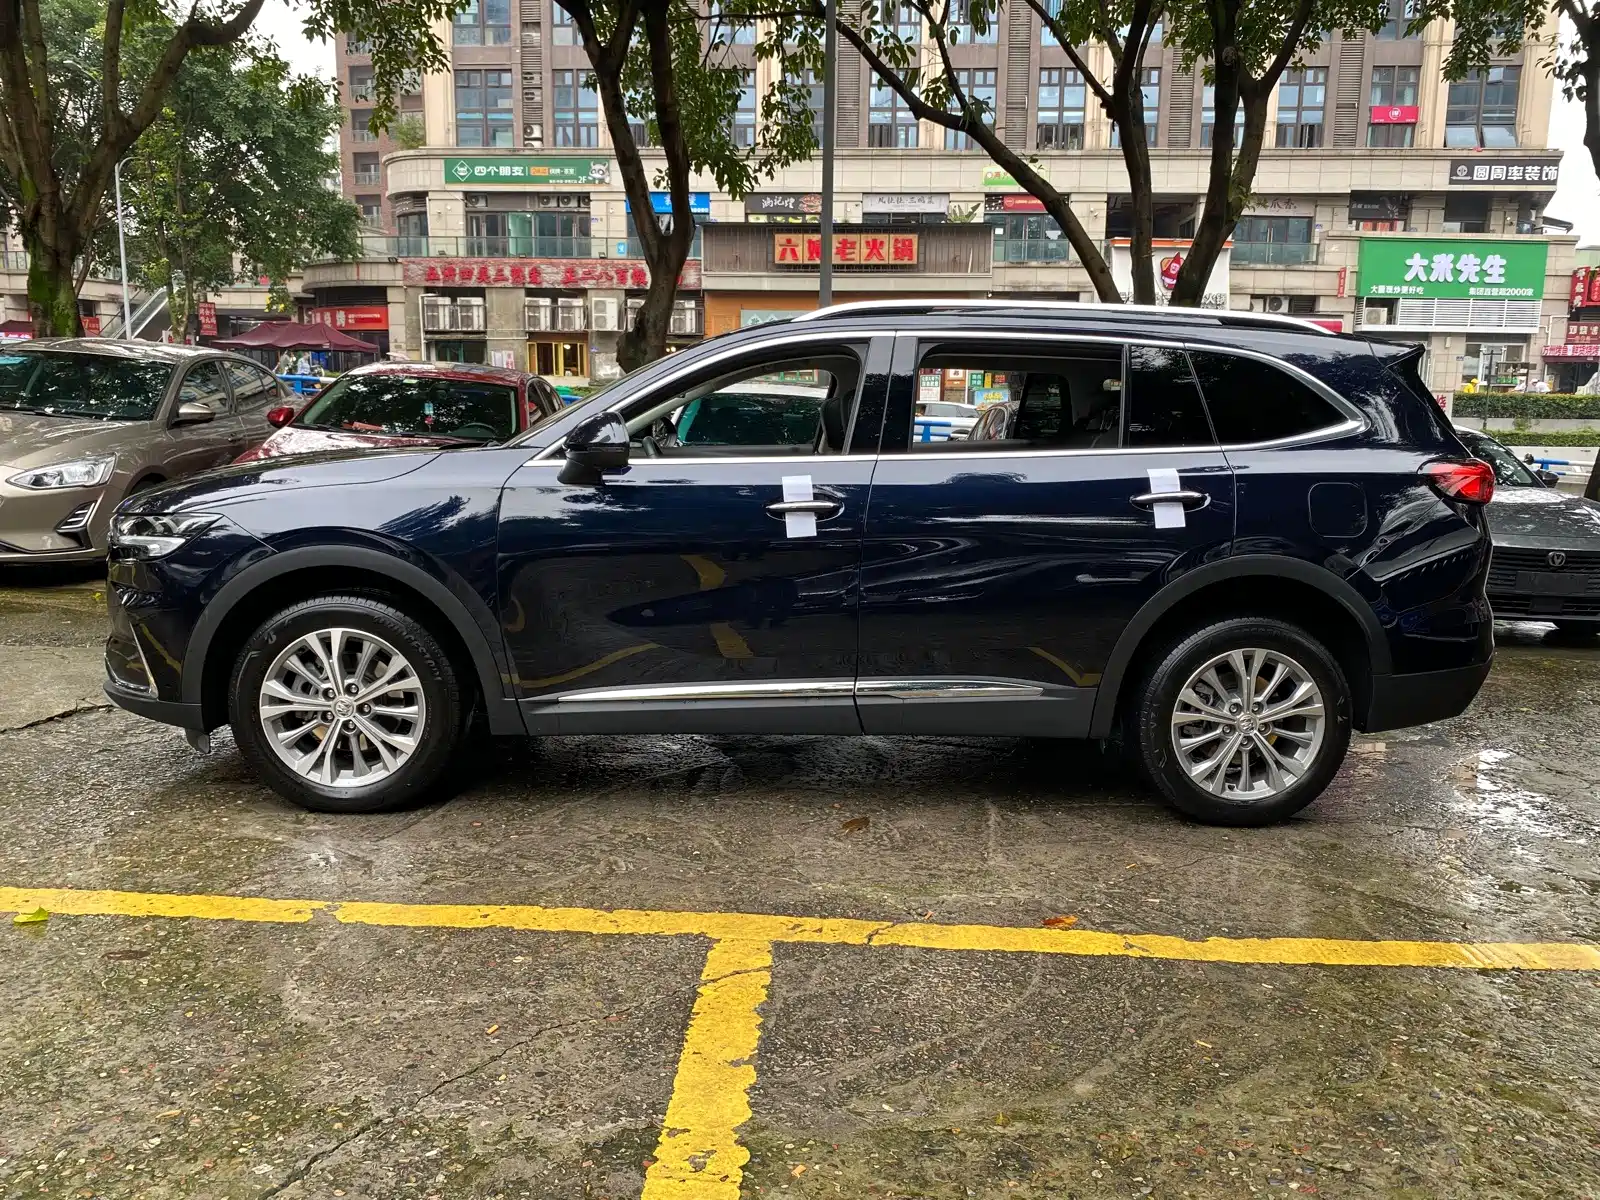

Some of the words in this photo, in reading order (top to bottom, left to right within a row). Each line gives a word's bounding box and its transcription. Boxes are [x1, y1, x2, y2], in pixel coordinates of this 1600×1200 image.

[1473, 165, 1558, 181] 圆周率装饰
[1404, 253, 1507, 284] 大米先生
